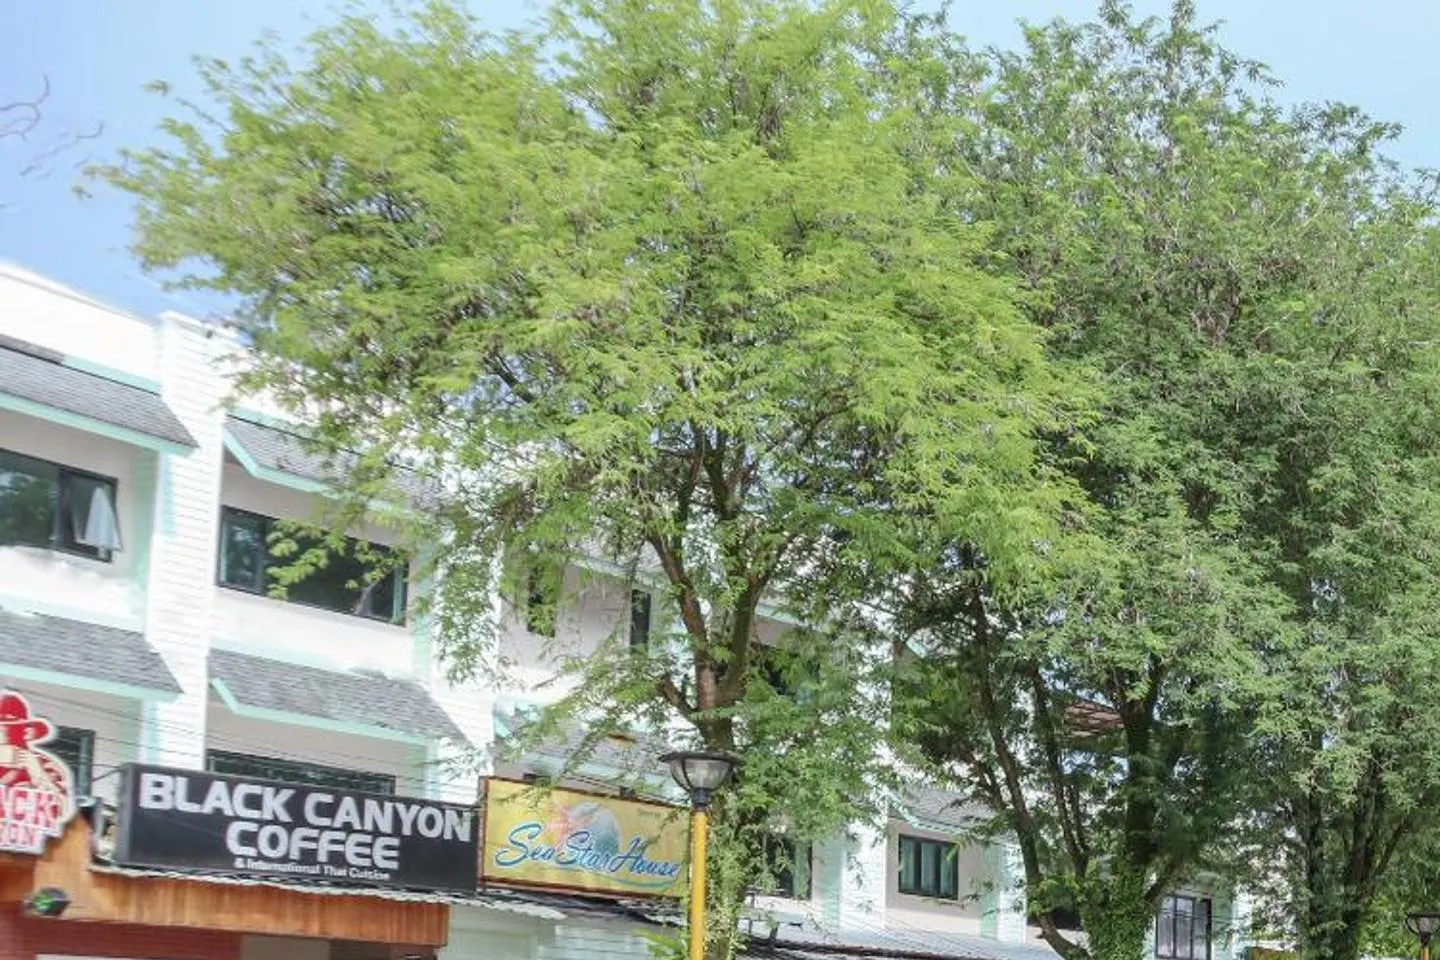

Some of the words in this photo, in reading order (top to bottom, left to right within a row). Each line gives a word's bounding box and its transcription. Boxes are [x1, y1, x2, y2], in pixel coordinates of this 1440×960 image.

[139, 773, 296, 823] BLACK
[303, 792, 472, 843] CANYON
[226, 821, 400, 870] COFFEE
[234, 857, 246, 869] &
[494, 823, 557, 867] Sea
[556, 831, 612, 871] Star
[609, 836, 679, 877] House
